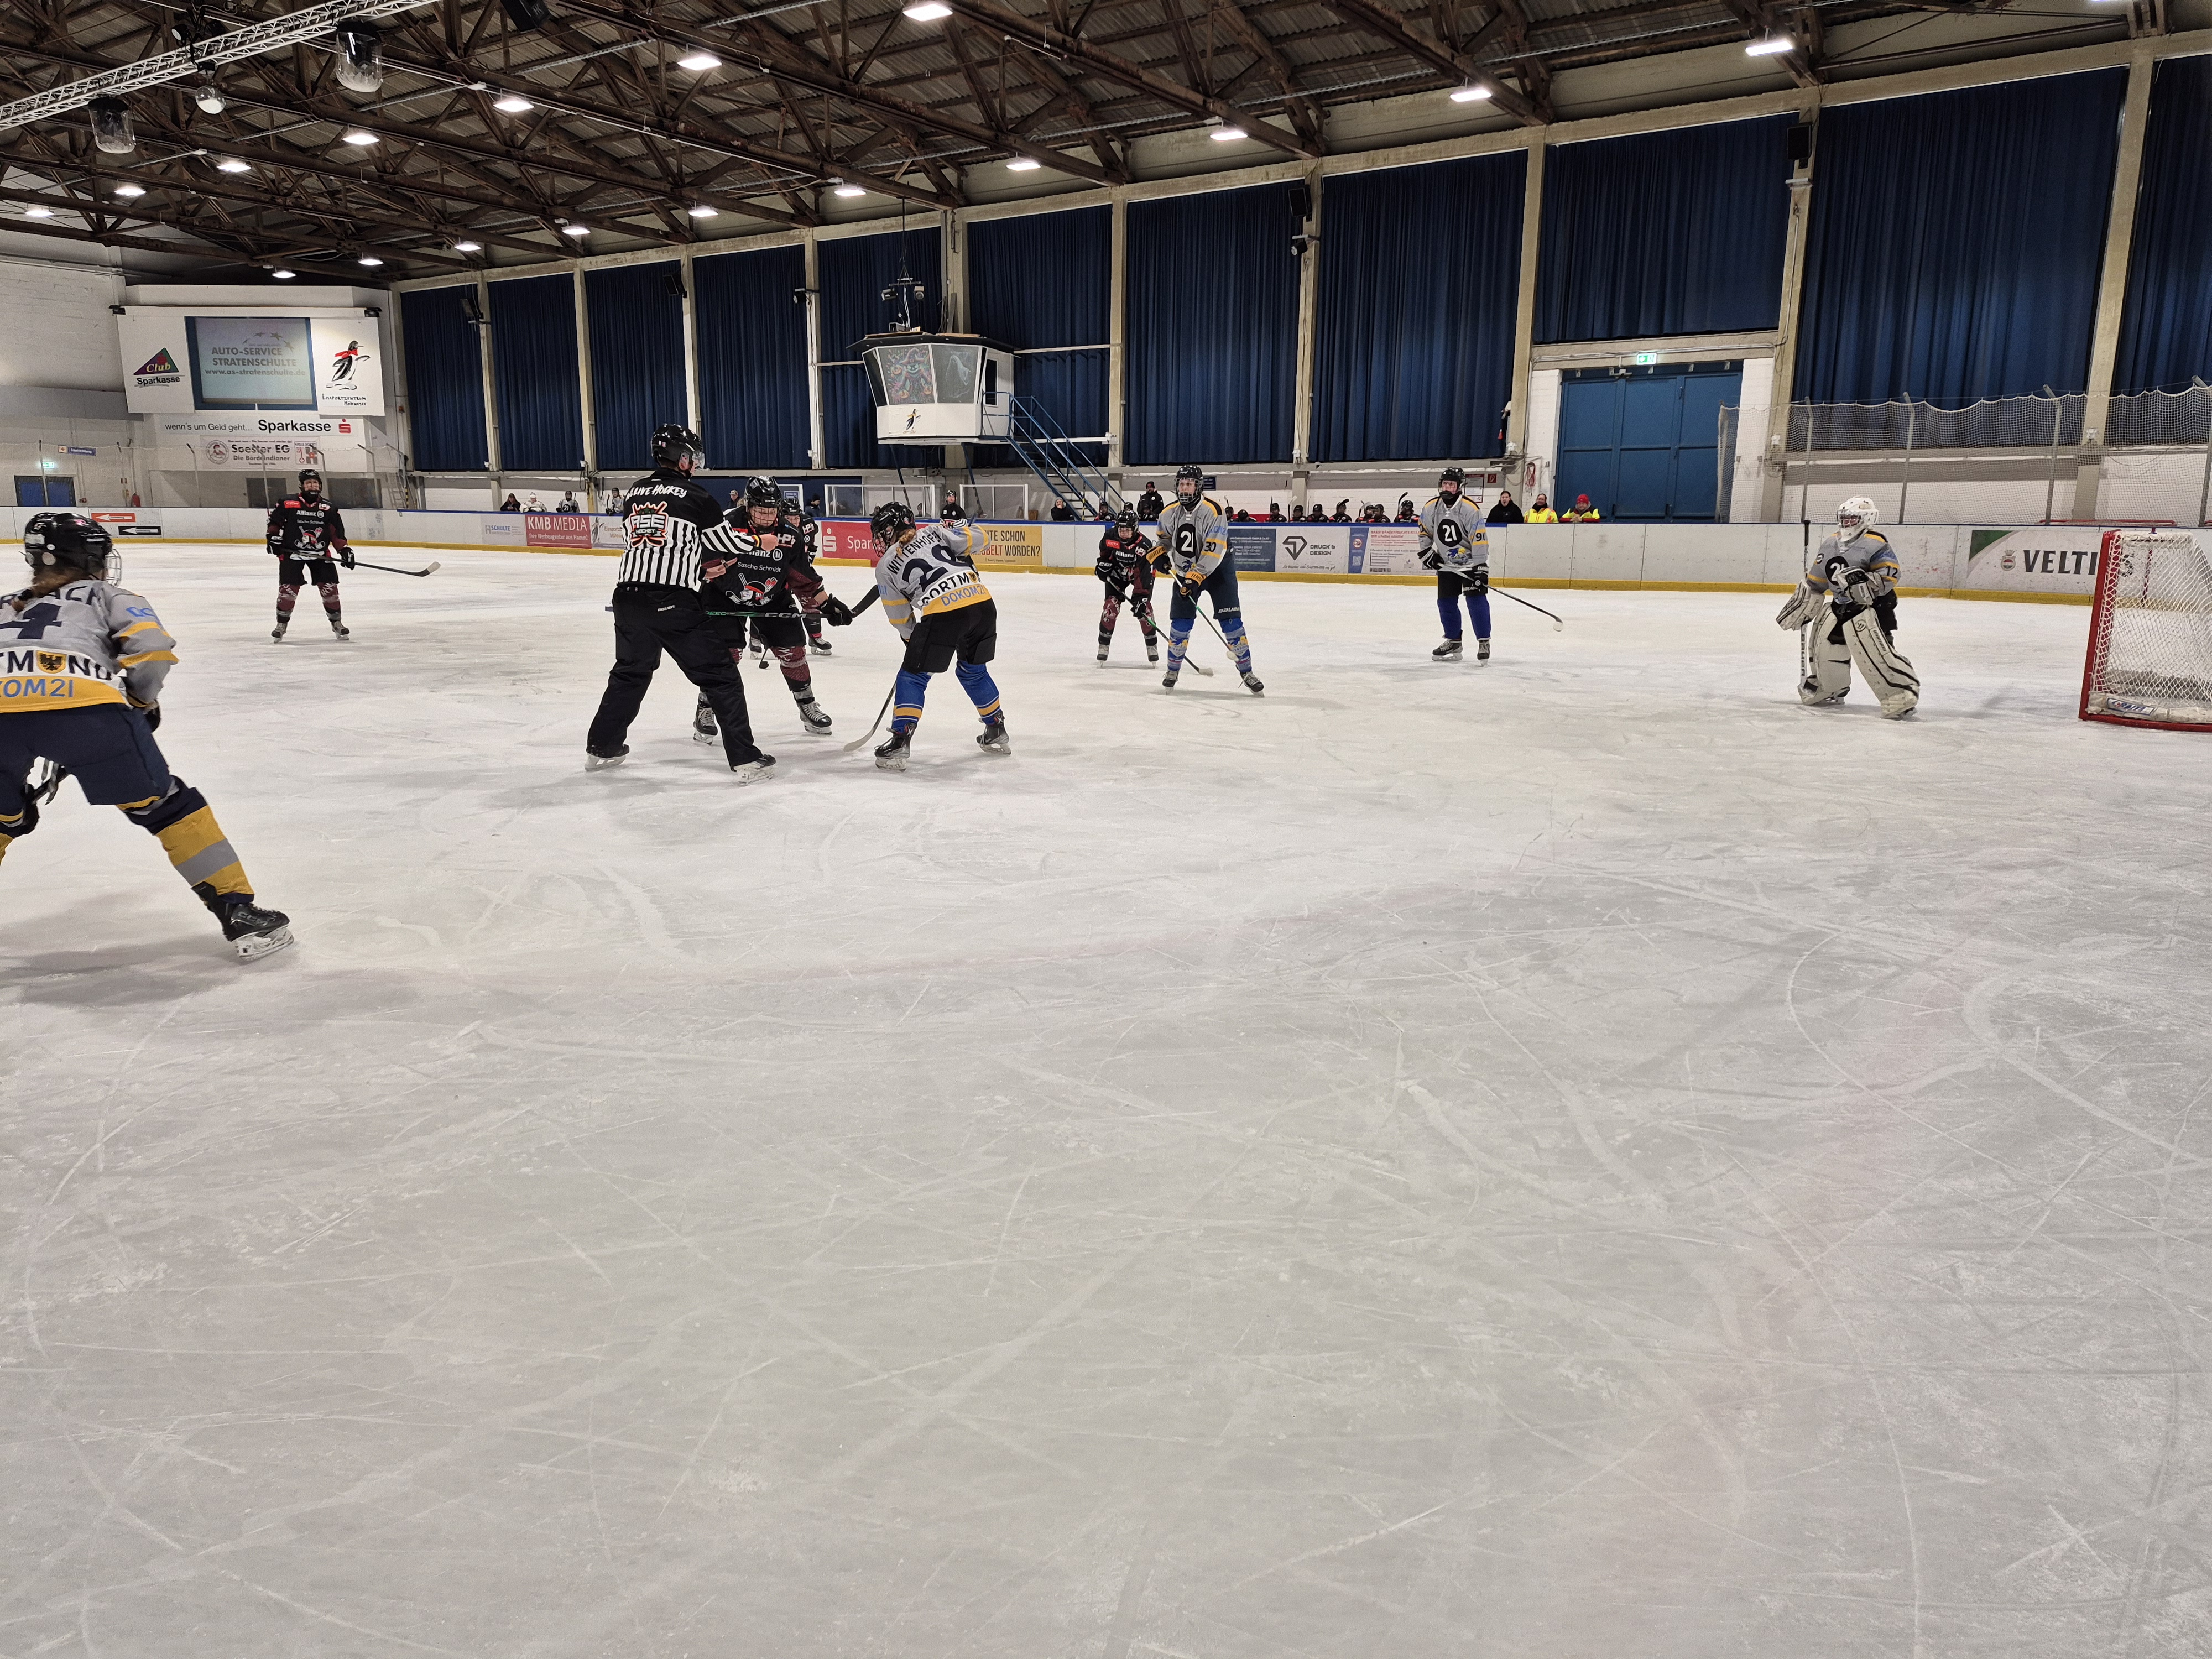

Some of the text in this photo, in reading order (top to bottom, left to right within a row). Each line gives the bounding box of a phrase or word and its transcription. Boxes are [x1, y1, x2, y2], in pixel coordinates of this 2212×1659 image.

[211, 347, 283, 356] AUTO-SERVICE
[146, 362, 171, 373] Club
[212, 357, 297, 367] STRATENSCHULTE
[137, 377, 180, 386] Sparkasse
[258, 419, 331, 434] Sparkasse
[231, 444, 290, 453] Soester EG
[528, 516, 587, 531] KMB MEDIA
[630, 514, 665, 529] ASE
[1000, 530, 1025, 542] SCHON
[1442, 525, 1458, 542] 21
[847, 535, 874, 552] Spar
[1180, 531, 1194, 552] 21
[1204, 541, 1217, 552] 30
[1005, 545, 1040, 557] WORDEN?
[737, 561, 758, 570] Sascha
[2023, 549, 2133, 577] VELTIS
[0, 679, 74, 698] OM21
